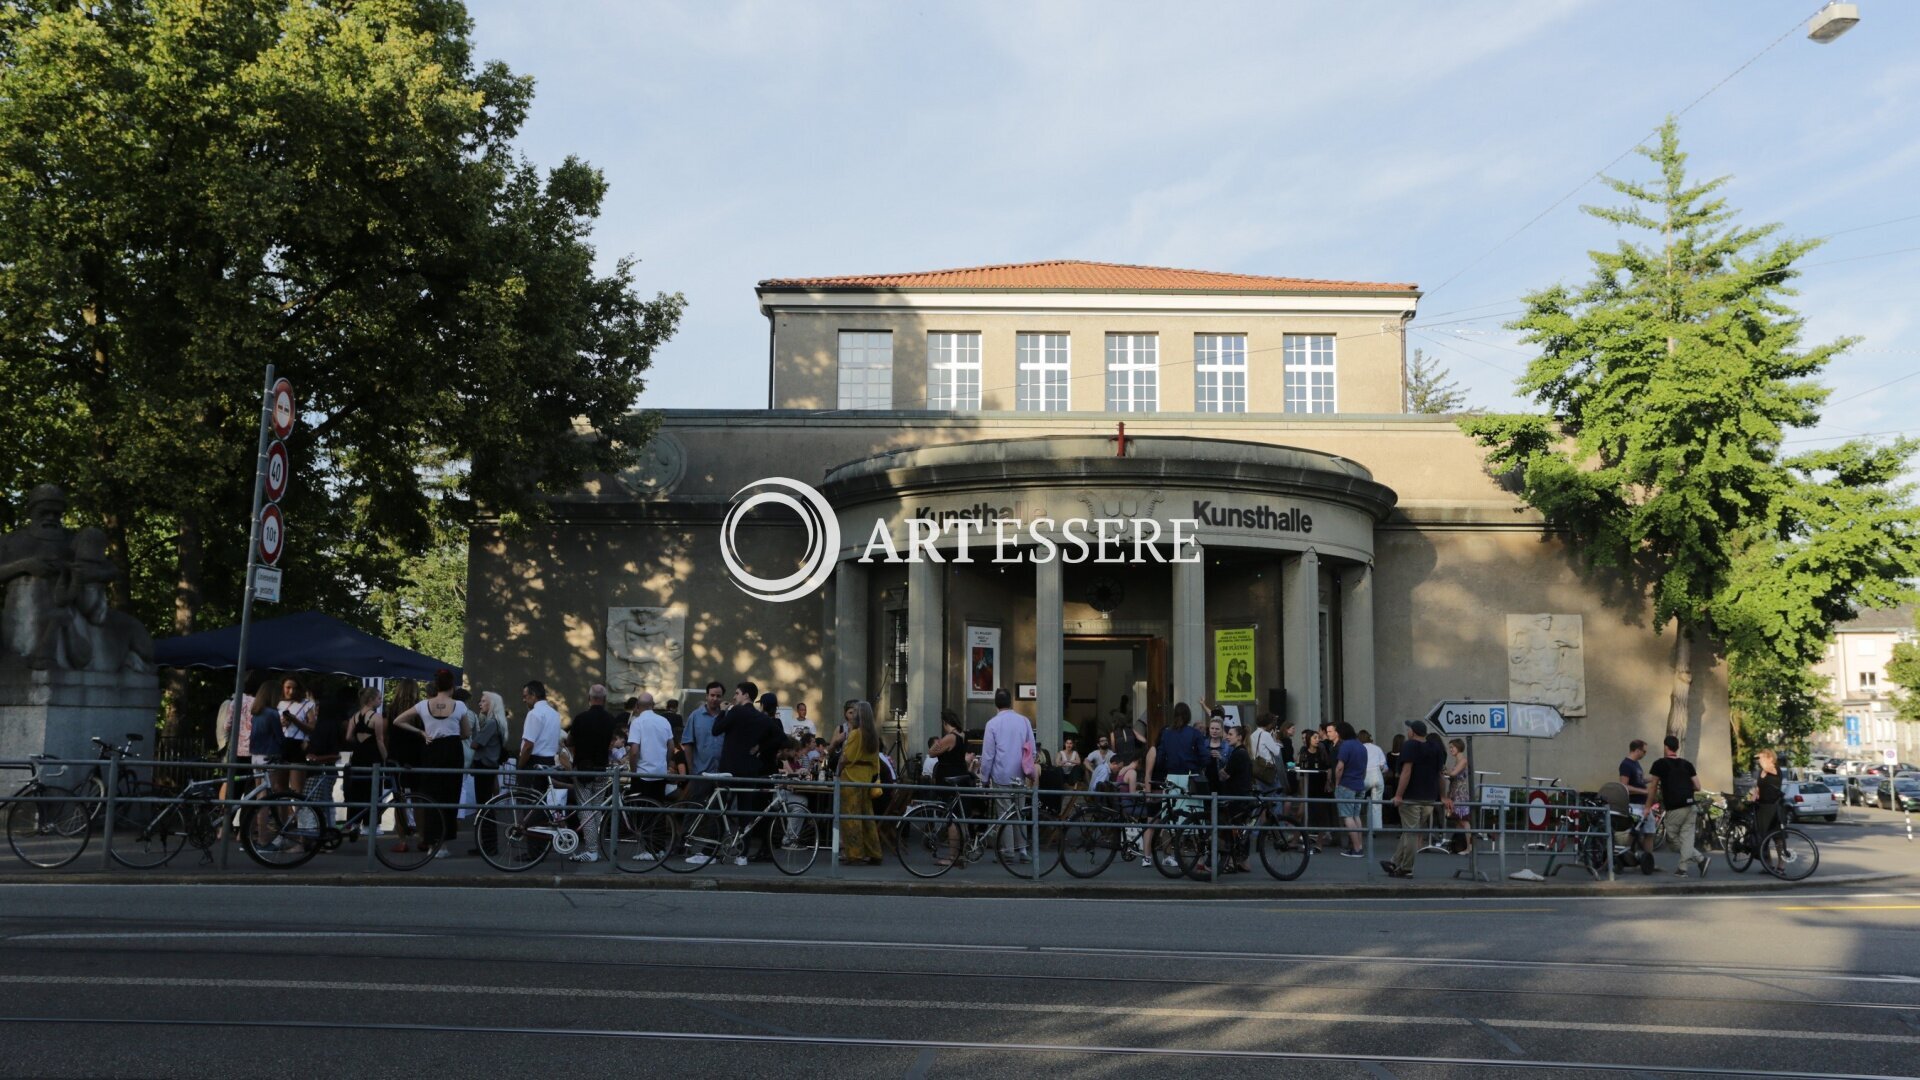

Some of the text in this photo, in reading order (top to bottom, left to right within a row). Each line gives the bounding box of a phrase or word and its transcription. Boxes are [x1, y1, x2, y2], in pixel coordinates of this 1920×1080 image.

[271, 461, 281, 482] 40
[1193, 500, 1313, 534] Kunsthalle
[1446, 711, 1486, 725] Casino
